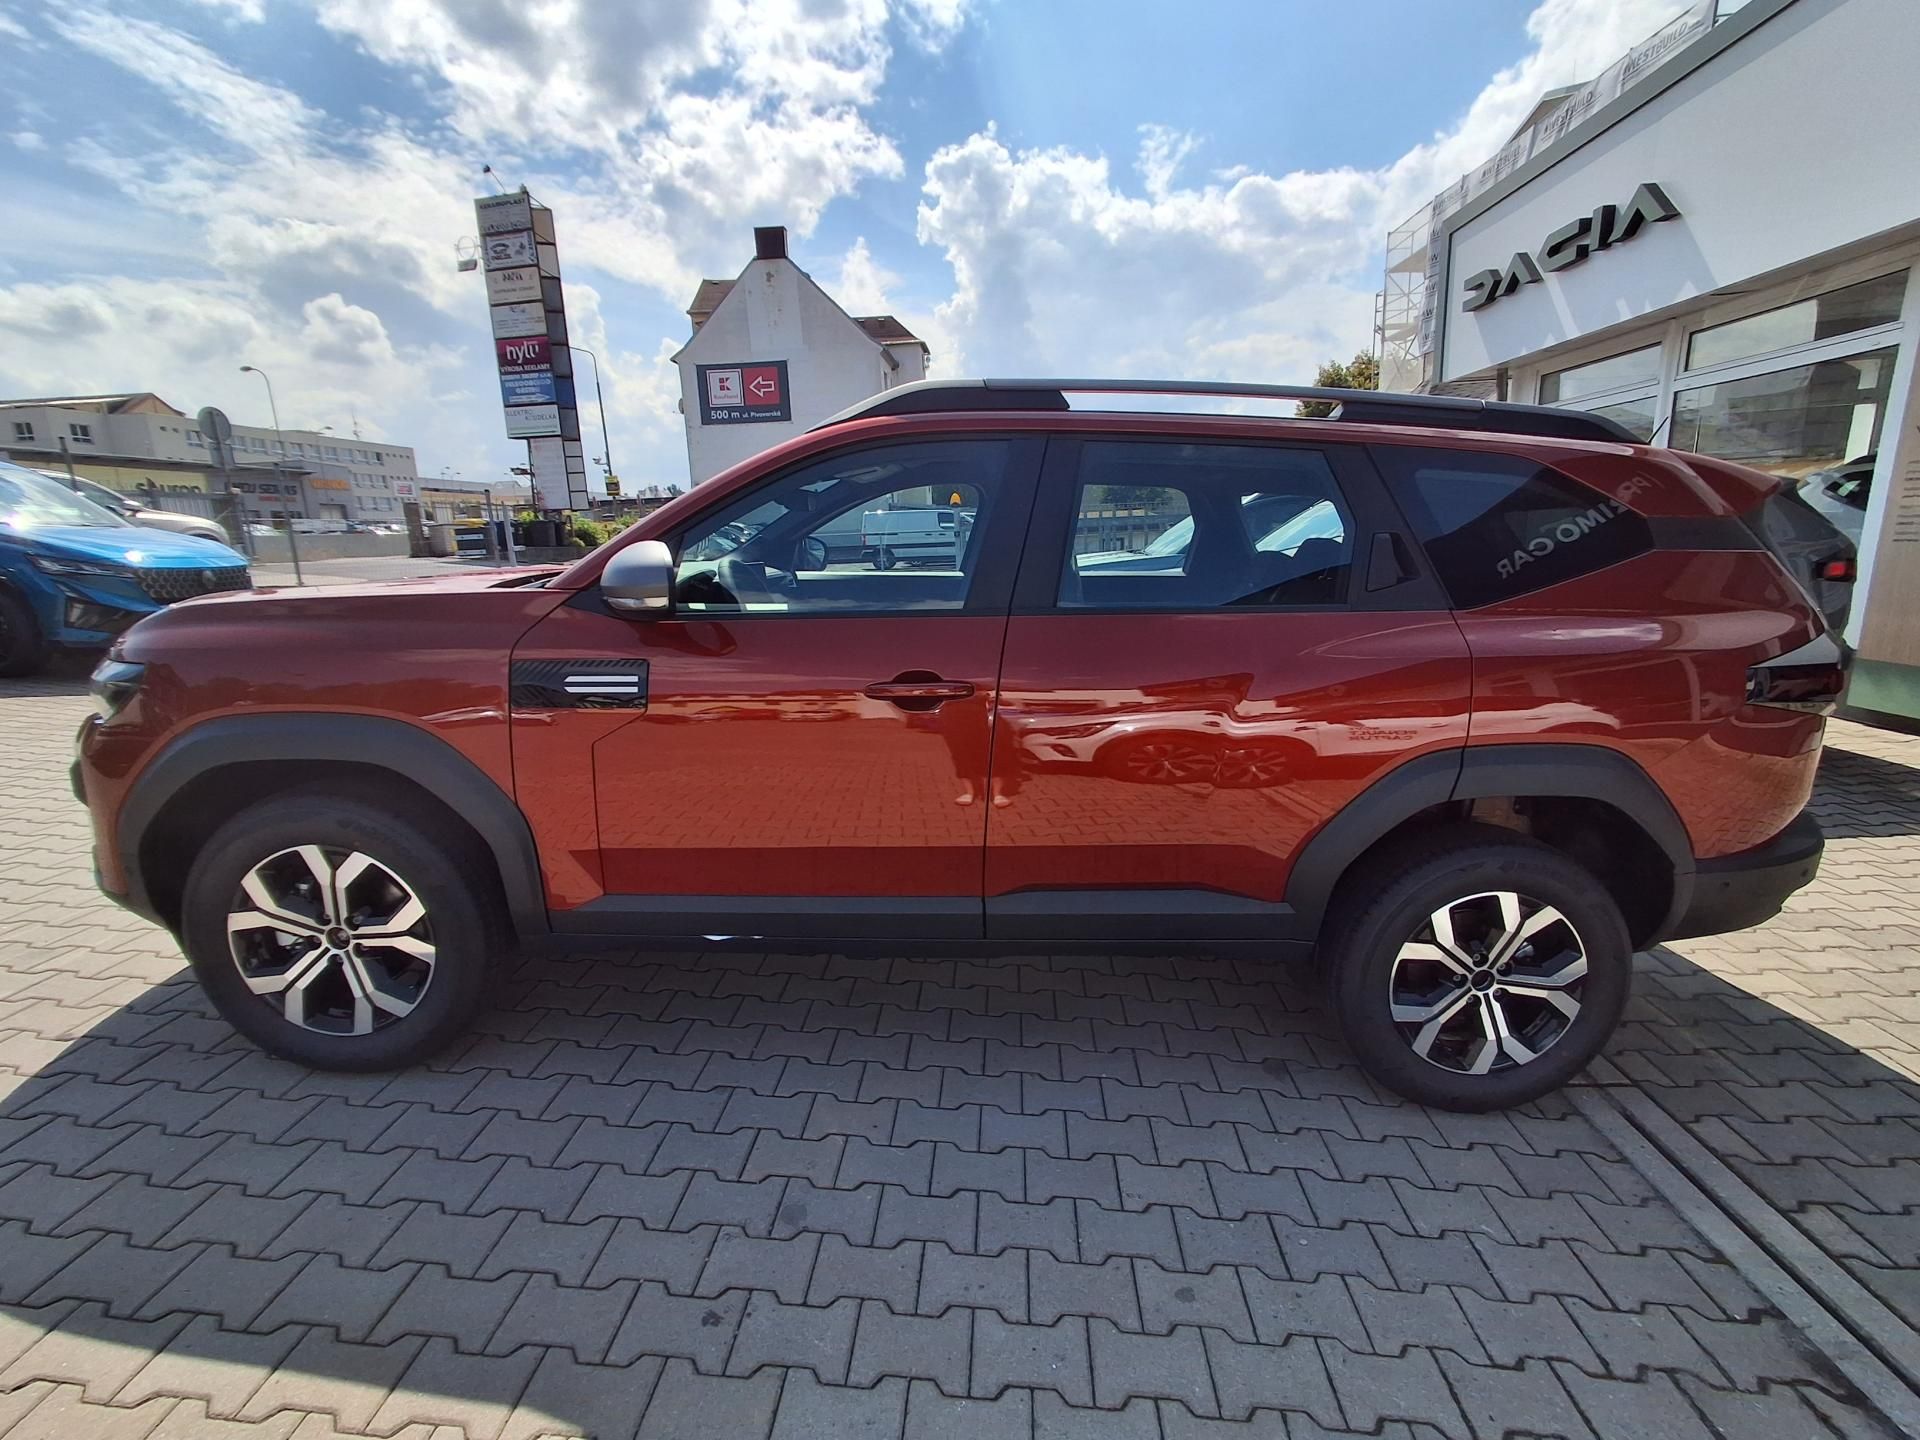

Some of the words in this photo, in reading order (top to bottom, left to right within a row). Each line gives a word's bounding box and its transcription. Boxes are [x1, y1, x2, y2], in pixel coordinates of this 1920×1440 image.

[1462, 182, 1682, 313] DACIA
[711, 410, 729, 420] 500
[731, 411, 740, 419] m
